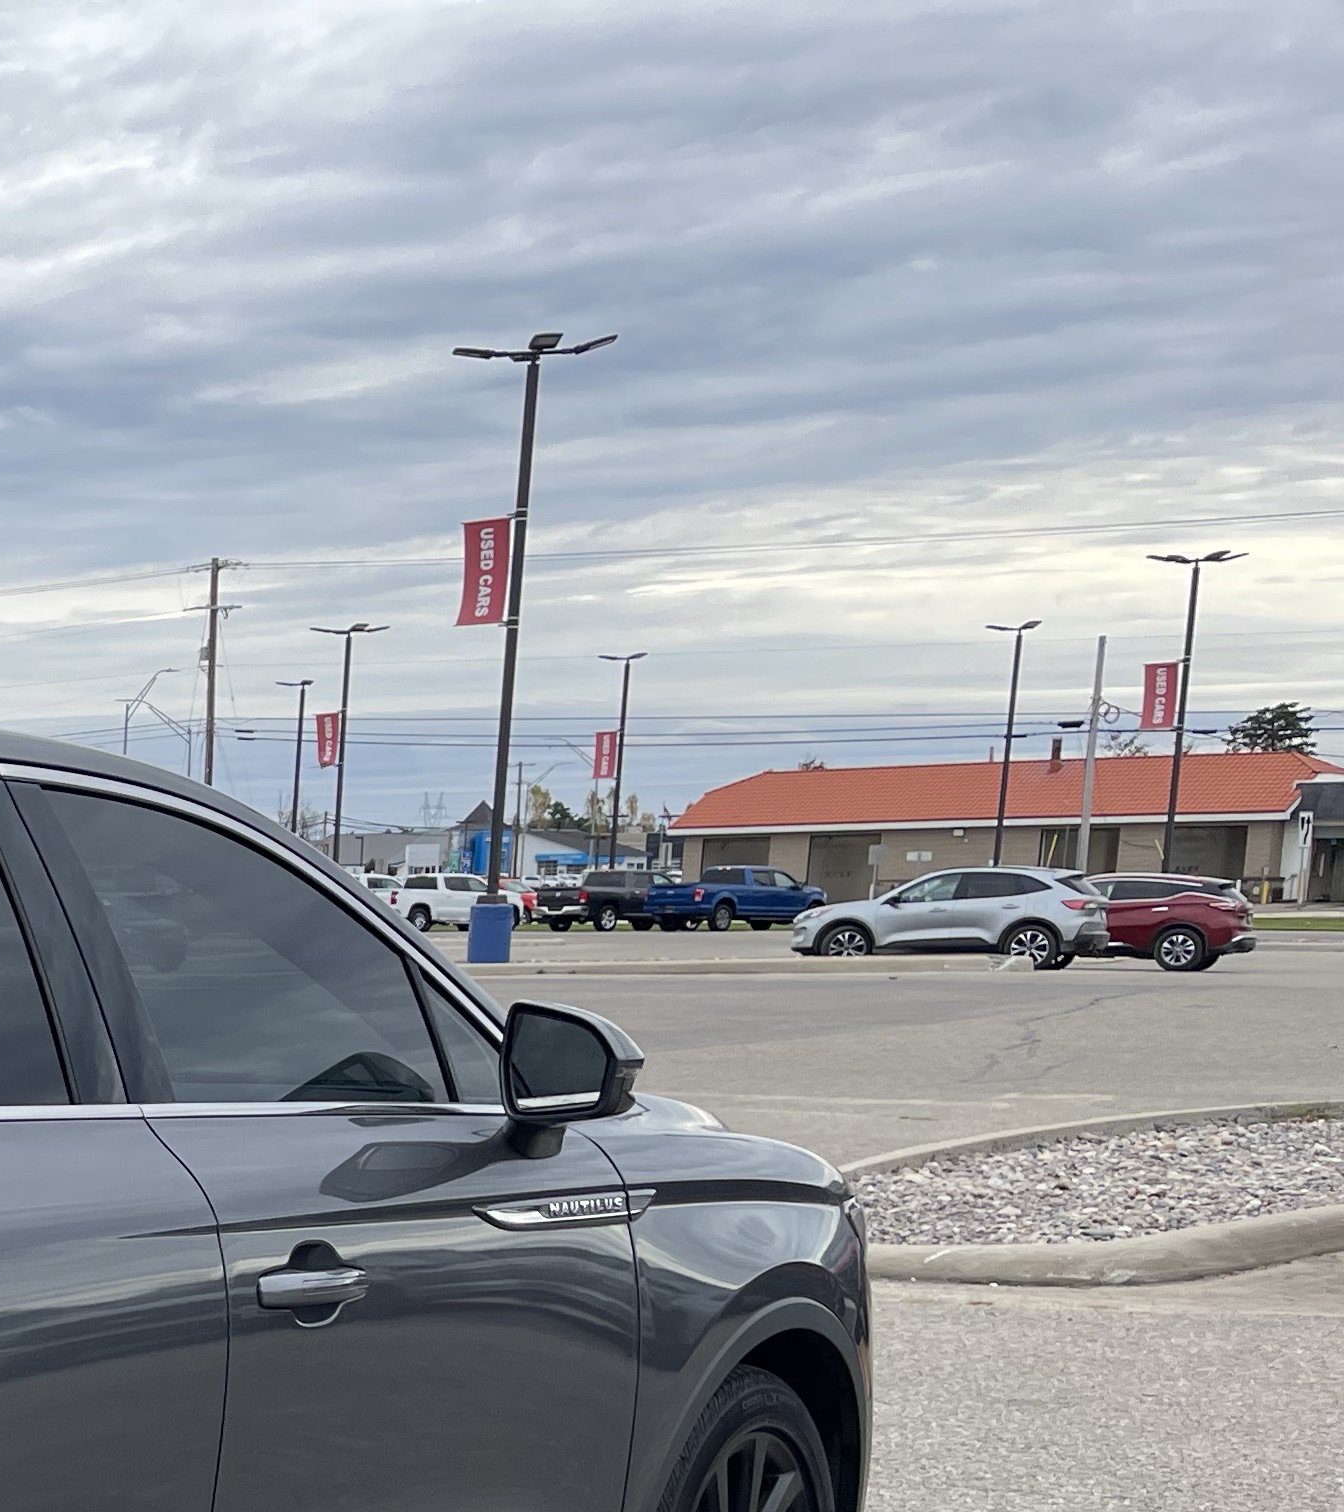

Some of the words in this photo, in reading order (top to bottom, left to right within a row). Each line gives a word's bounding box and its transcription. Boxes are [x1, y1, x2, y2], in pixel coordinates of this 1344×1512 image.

[479, 527, 494, 571] USED
[474, 574, 493, 617] CARS
[1155, 667, 1167, 695] USED
[1152, 696, 1166, 725] CARS
[549, 1197, 623, 1216] NAUTILUS
